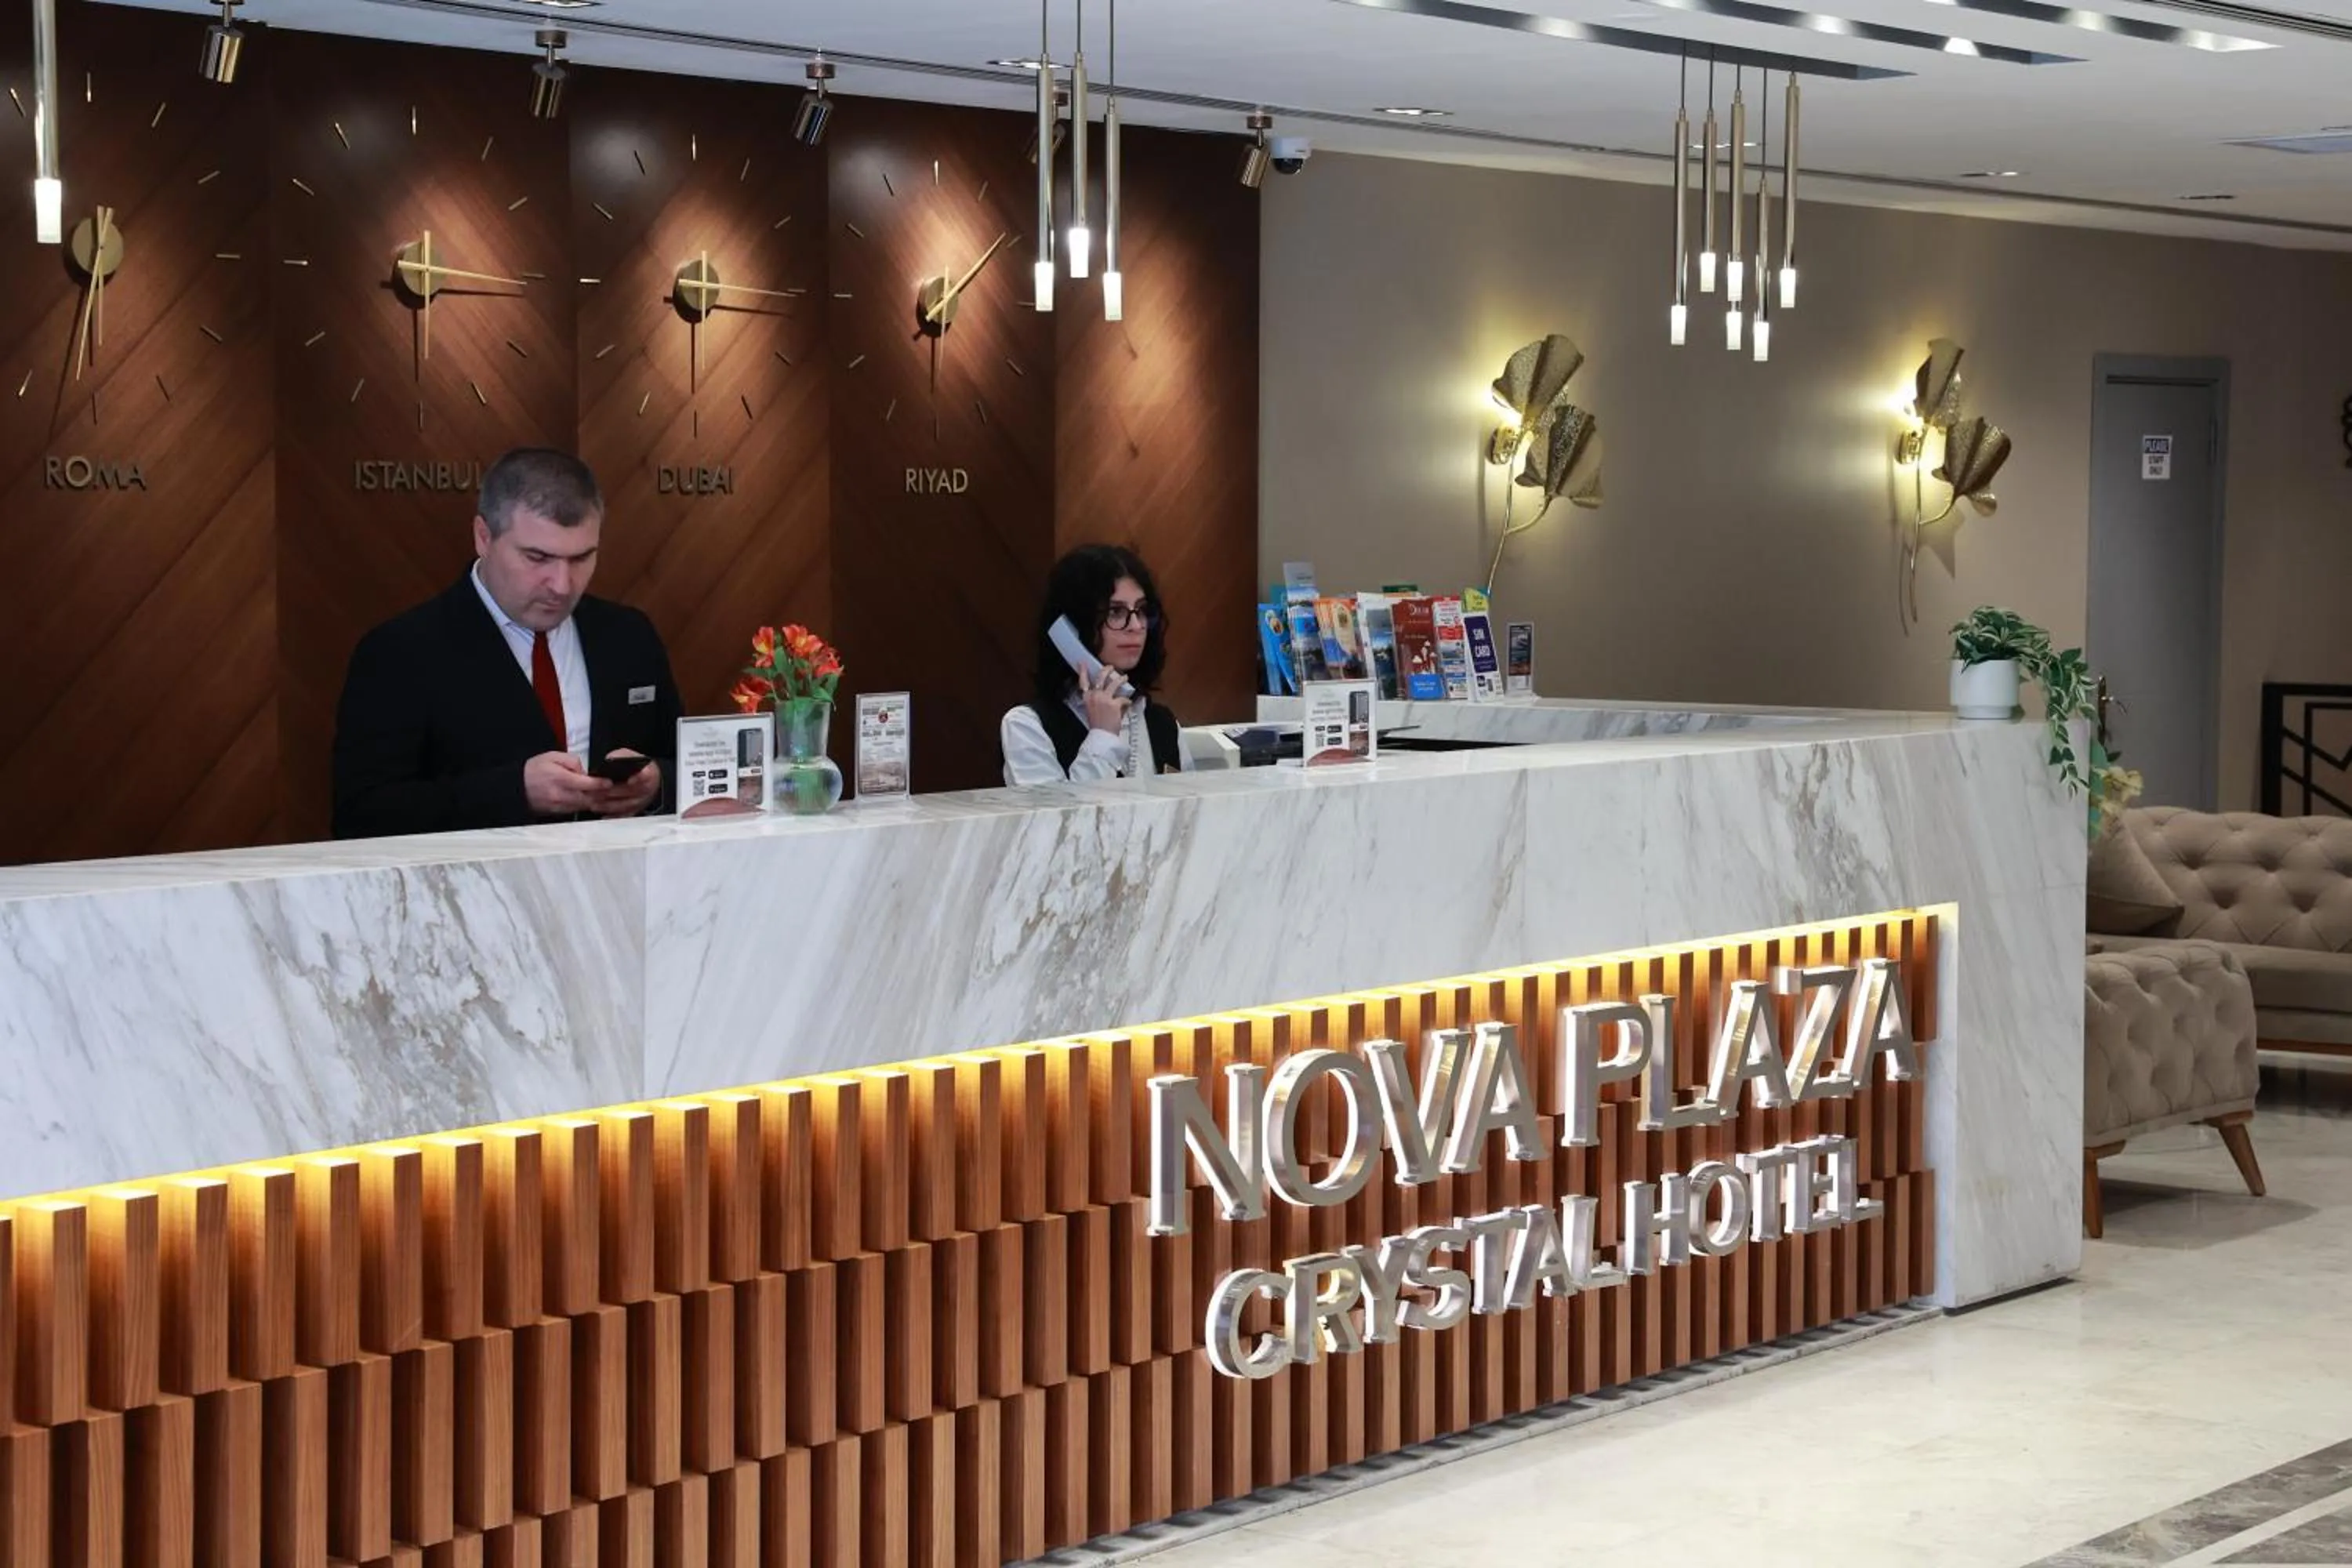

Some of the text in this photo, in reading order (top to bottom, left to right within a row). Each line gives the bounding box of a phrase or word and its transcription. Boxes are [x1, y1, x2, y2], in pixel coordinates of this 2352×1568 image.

[45, 456, 146, 490] ROMA
[658, 466, 734, 495] DUBAI
[906, 467, 968, 494] RIYAD
[1475, 644, 1491, 658] CARD
[1147, 958, 1922, 1236] NOVA PLAZA
[1205, 1134, 1884, 1379] CRYSTAL HOTEL
